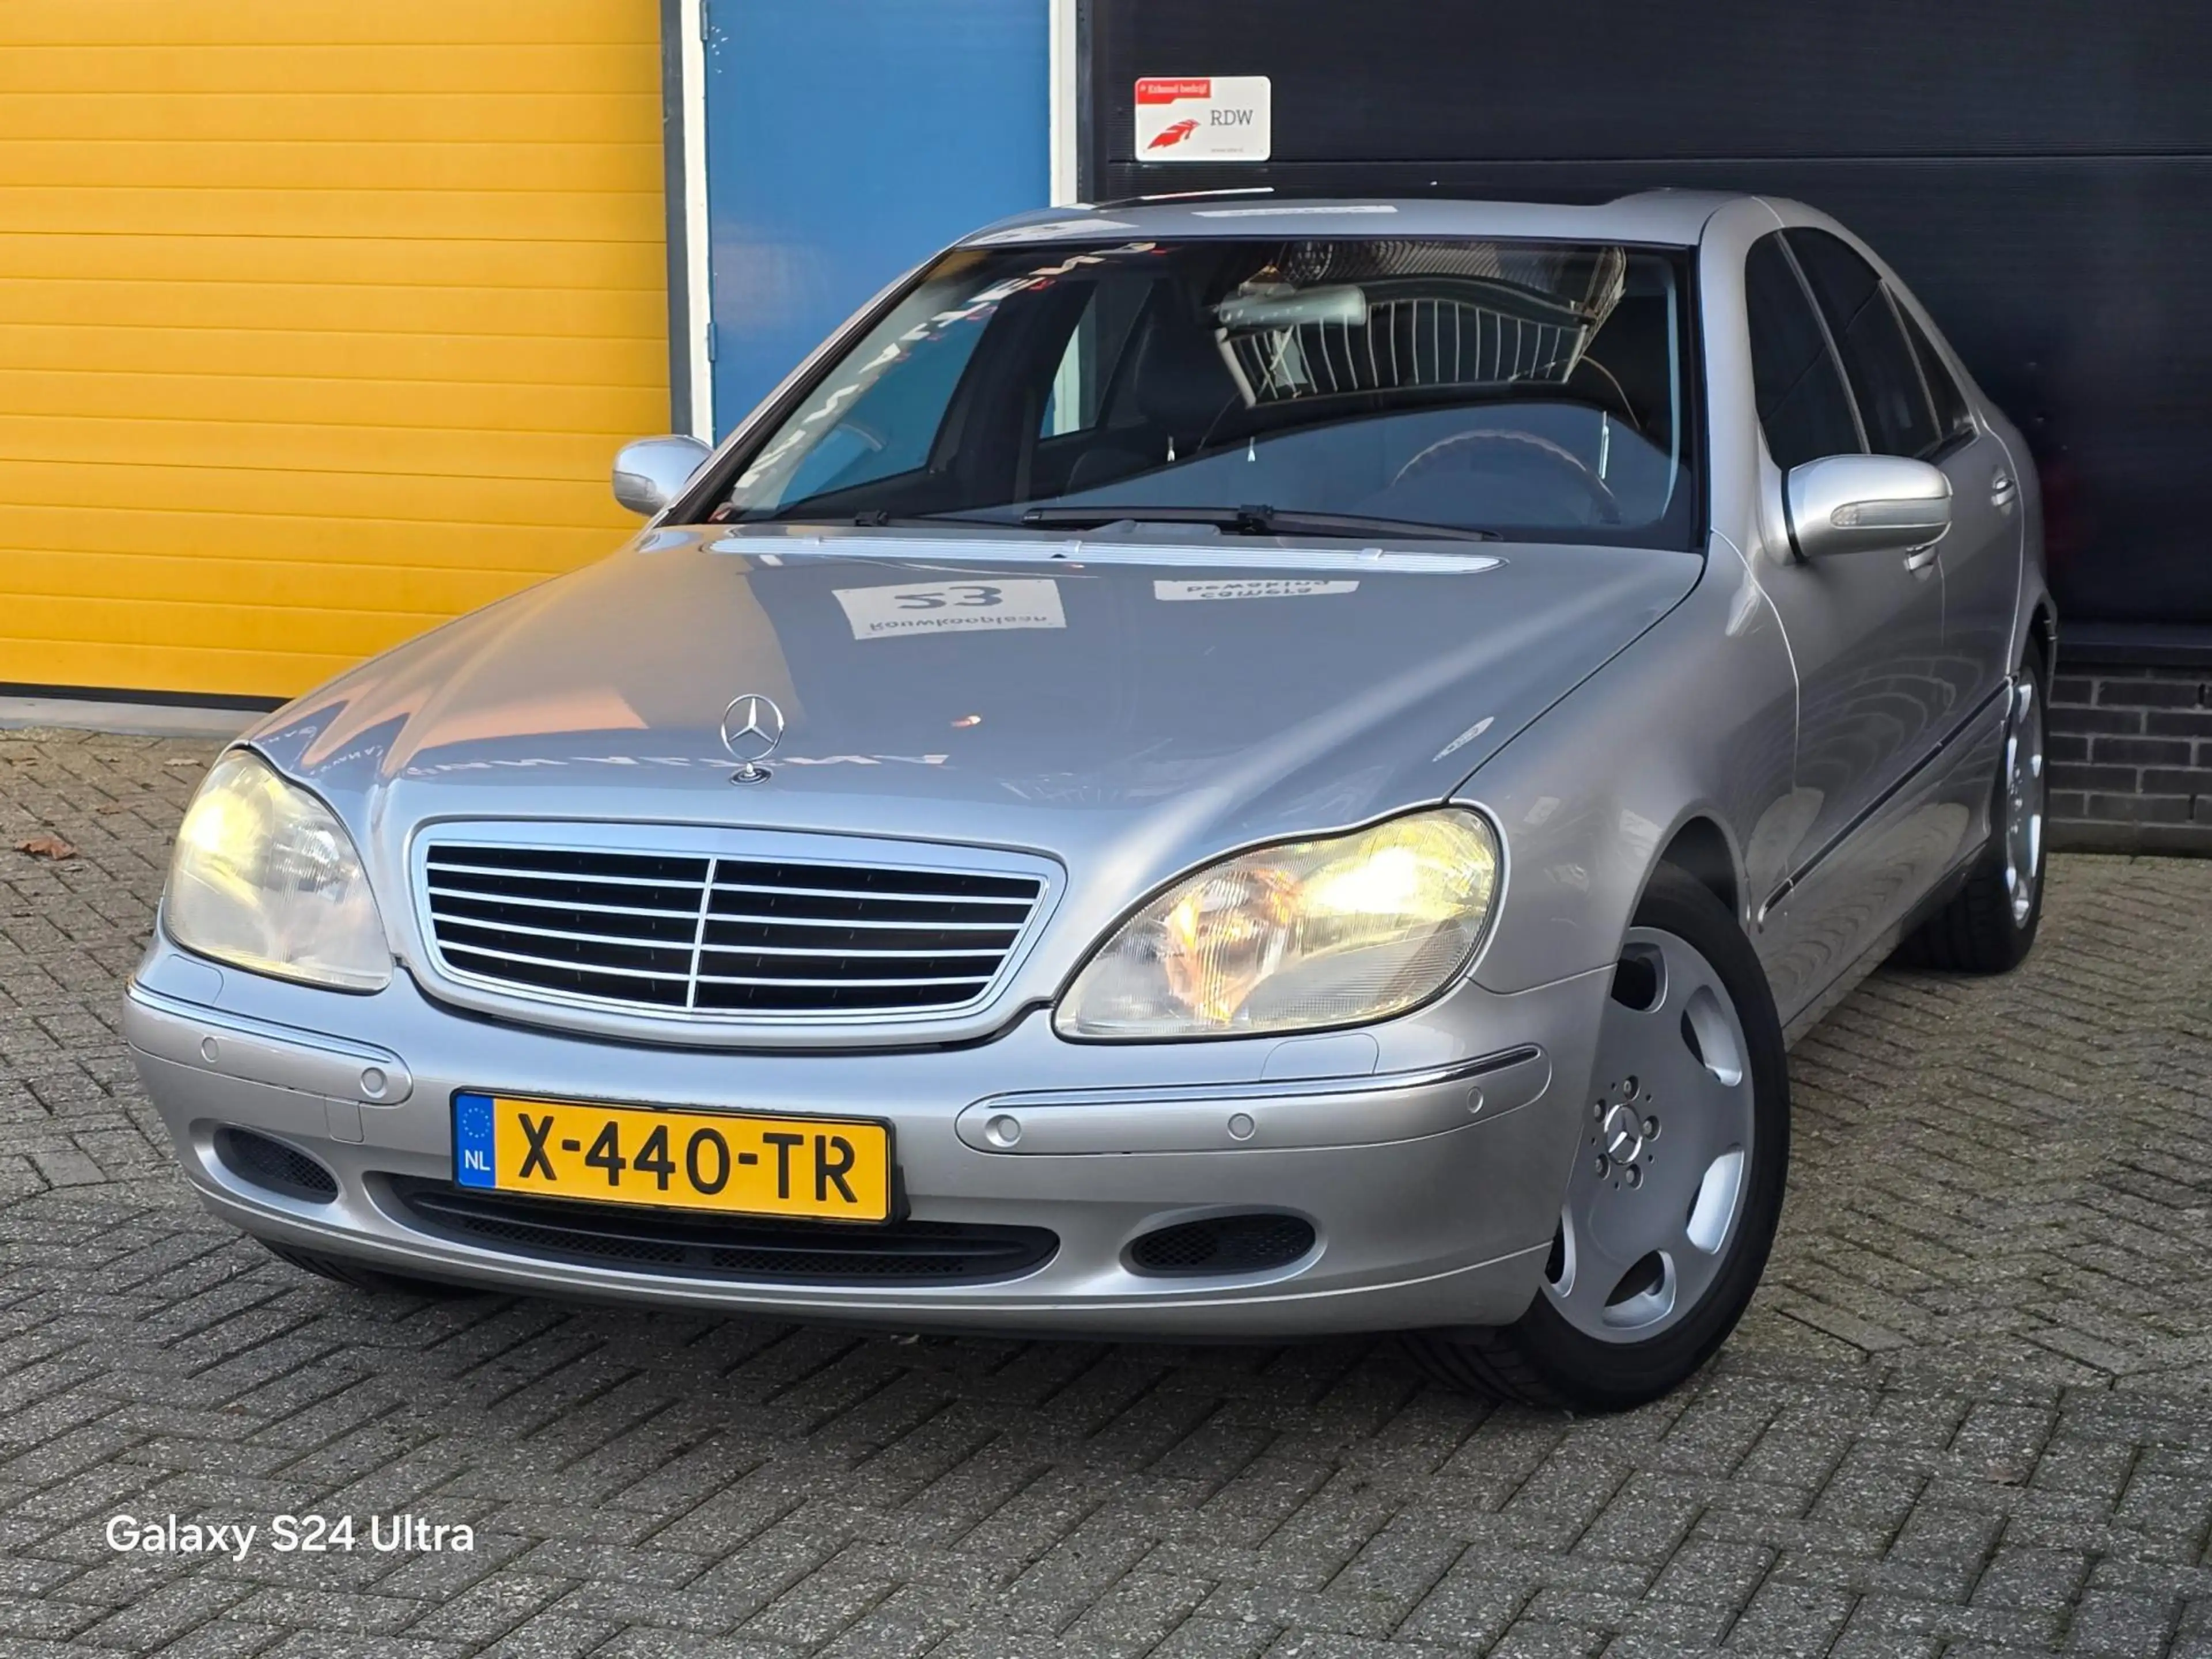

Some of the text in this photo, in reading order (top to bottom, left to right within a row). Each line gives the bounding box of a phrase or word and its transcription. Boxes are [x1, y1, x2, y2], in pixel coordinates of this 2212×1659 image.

[1210, 109, 1253, 126] RDW
[464, 1149, 490, 1171] NL
[517, 1112, 858, 1203] X-440-TR
